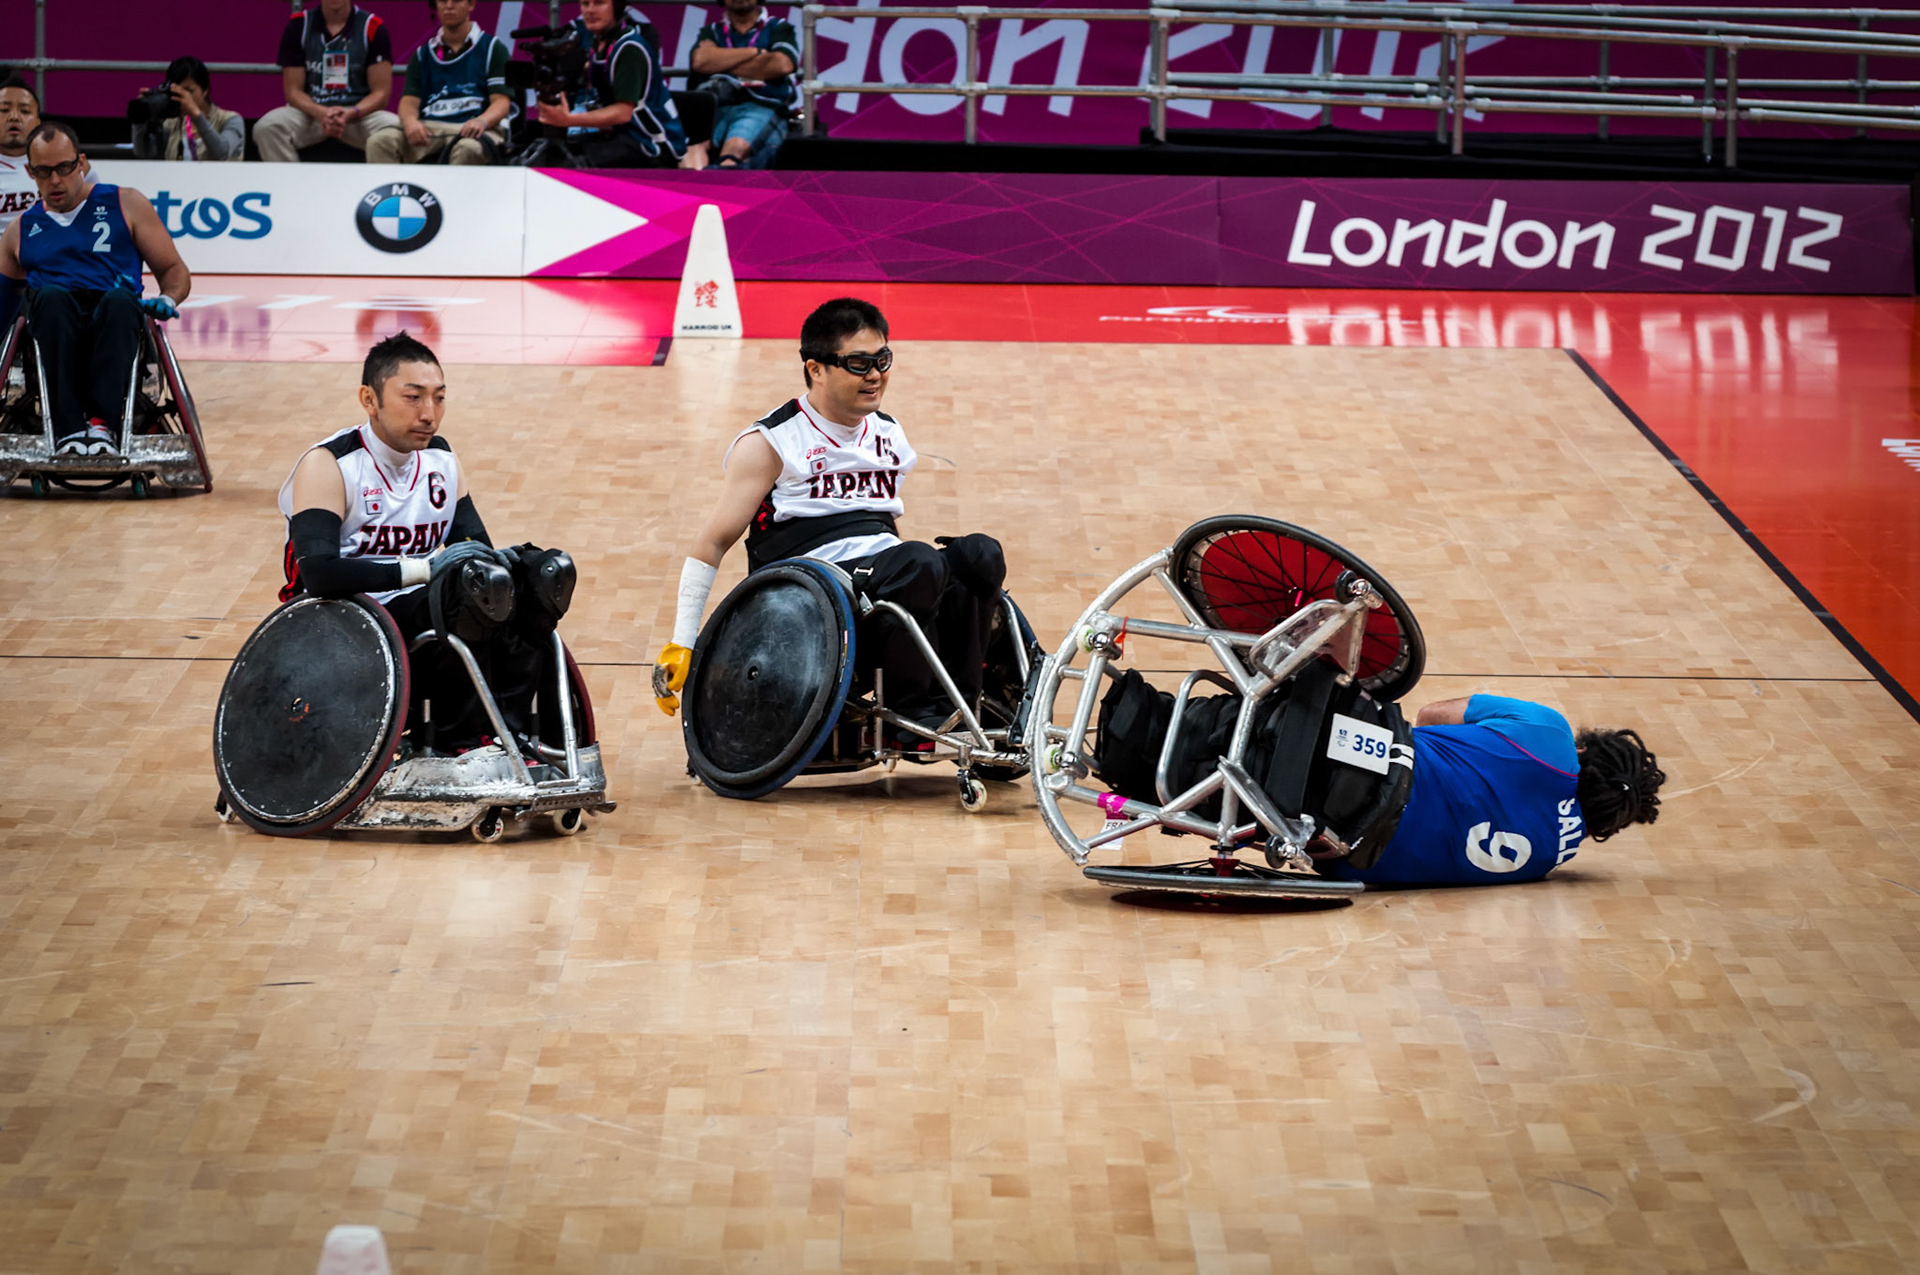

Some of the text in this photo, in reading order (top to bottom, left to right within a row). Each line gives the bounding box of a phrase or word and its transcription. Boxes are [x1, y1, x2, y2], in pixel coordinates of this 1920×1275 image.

[364, 183, 437, 209] BMW
[150, 190, 273, 240] tos
[92, 221, 112, 253] 2
[1287, 198, 1844, 273] London 2012
[427, 471, 448, 509] 6
[805, 469, 899, 499] JAPAN
[346, 520, 449, 557] JAPAN
[1352, 734, 1387, 759] 359
[1465, 821, 1533, 873] 9
